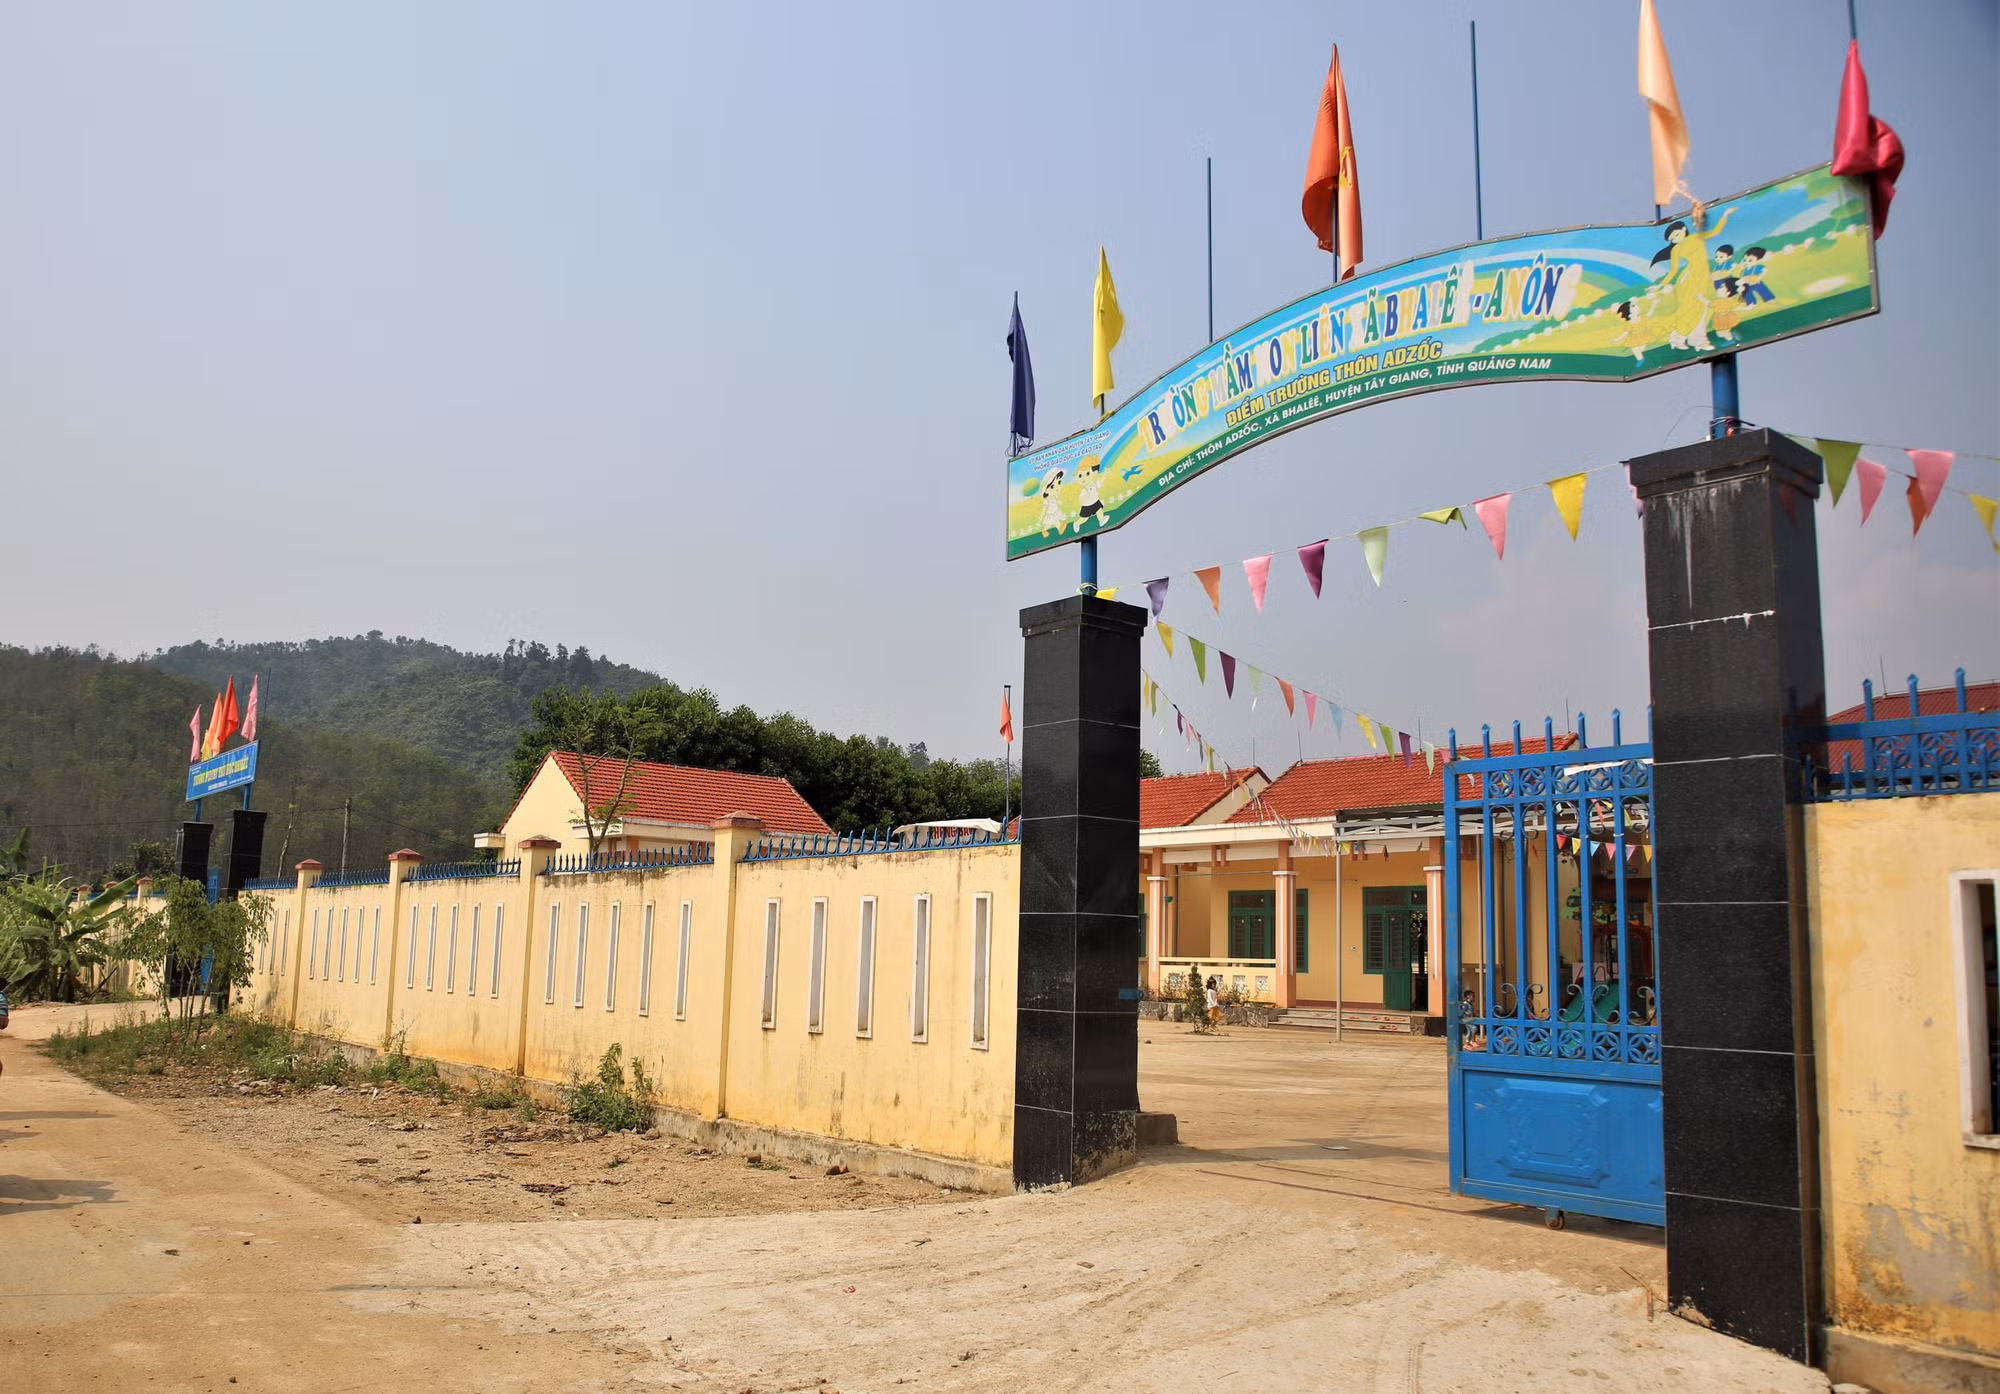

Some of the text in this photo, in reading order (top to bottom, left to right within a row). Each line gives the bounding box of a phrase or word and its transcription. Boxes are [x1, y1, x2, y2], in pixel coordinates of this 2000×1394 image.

[1300, 303, 1345, 367] LIÊN
[1158, 472, 1175, 486] ĐỊA
[1196, 441, 1223, 460] THÔN
[1225, 422, 1262, 445] ADZỐC,
[1264, 412, 1280, 427] XÃ
[1282, 395, 1322, 419] BHALÊÊ,
[1325, 384, 1361, 403] HUYỆN
[1364, 377, 1386, 391] TÂY
[1388, 368, 1432, 384] GIANG,
[1467, 356, 1517, 372] QUẢNG
[1519, 358, 1552, 369] NAM
[1226, 336, 1442, 427] ĐIỂM TRƯỜNG THÔN ADZỐC
